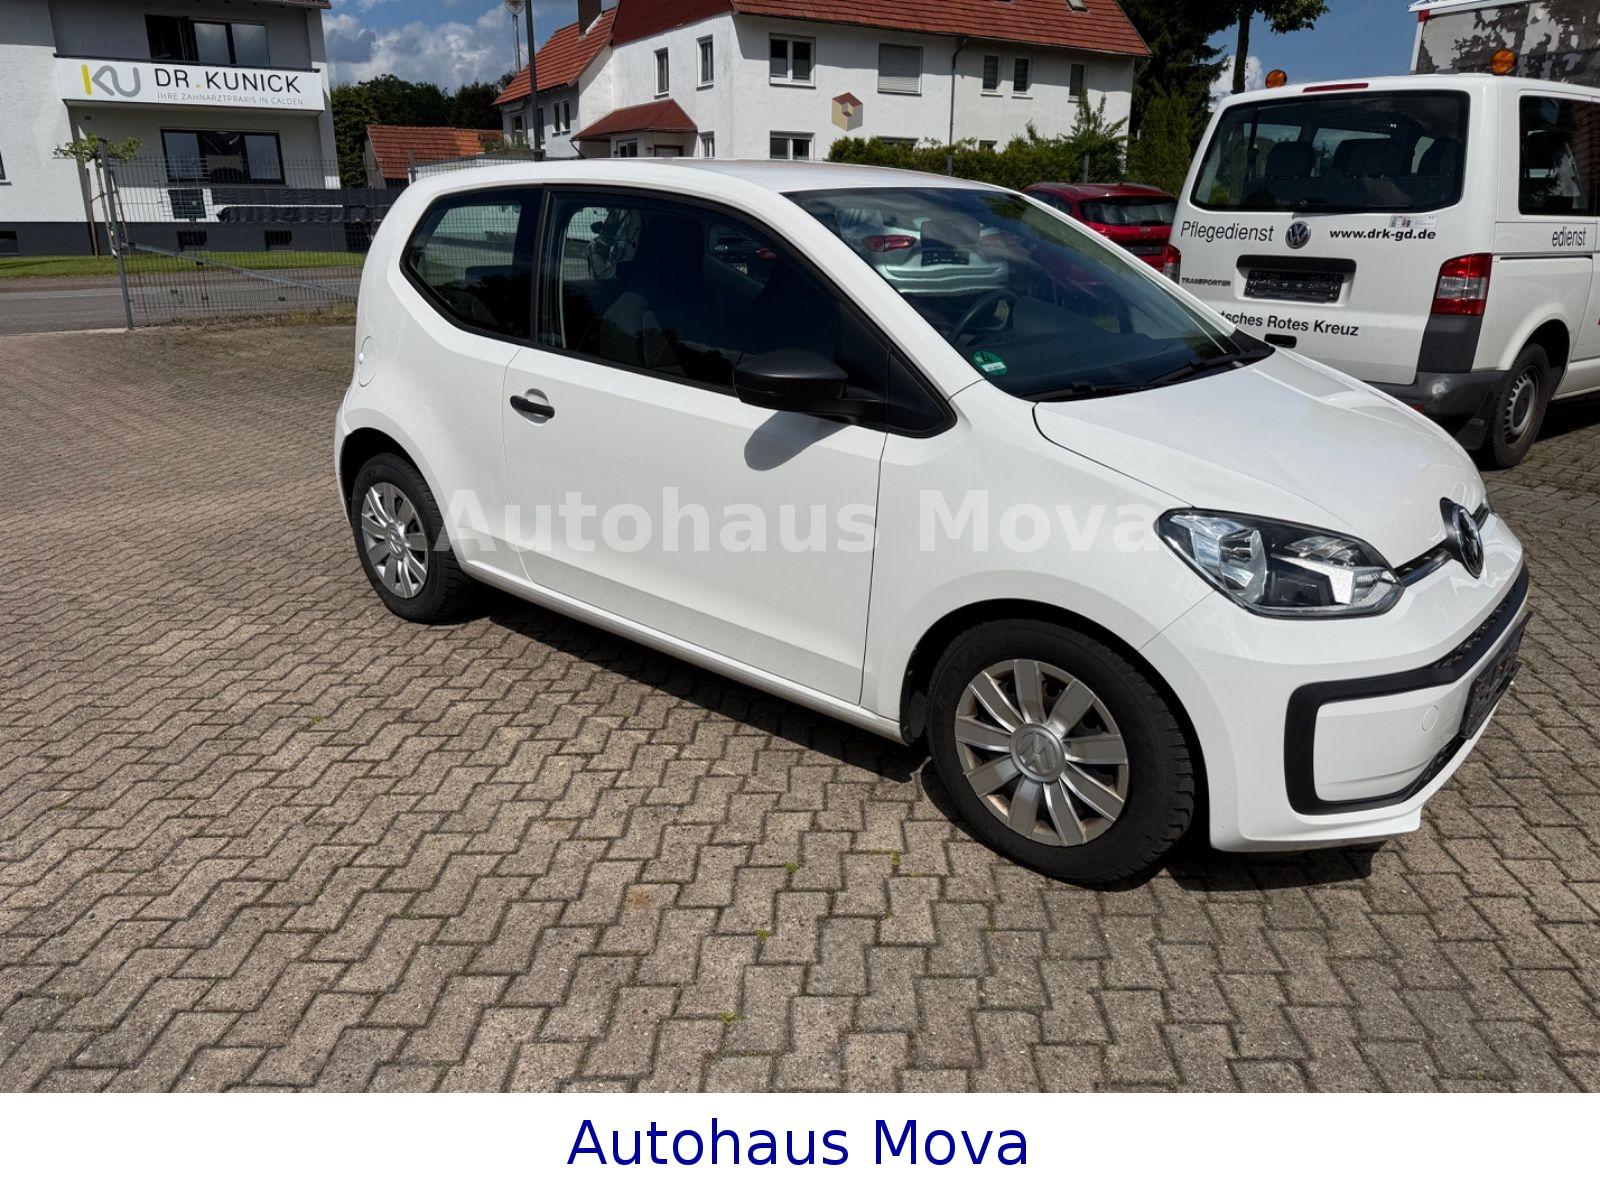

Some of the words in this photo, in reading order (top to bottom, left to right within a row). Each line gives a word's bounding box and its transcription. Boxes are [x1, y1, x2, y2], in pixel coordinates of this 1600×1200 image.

[205, 70, 301, 94] KUNICK
[157, 91, 178, 100] IHRE
[181, 92, 257, 104] ZAHNARZTPRAXIS
[271, 96, 304, 105] CALDEN
[1181, 221, 1274, 242] Pflegedienst
[1330, 228, 1436, 241] www.drk-gd.de
[1552, 226, 1586, 247] edienst
[1266, 315, 1309, 332] Rotes
[1313, 319, 1359, 337] Kreuz
